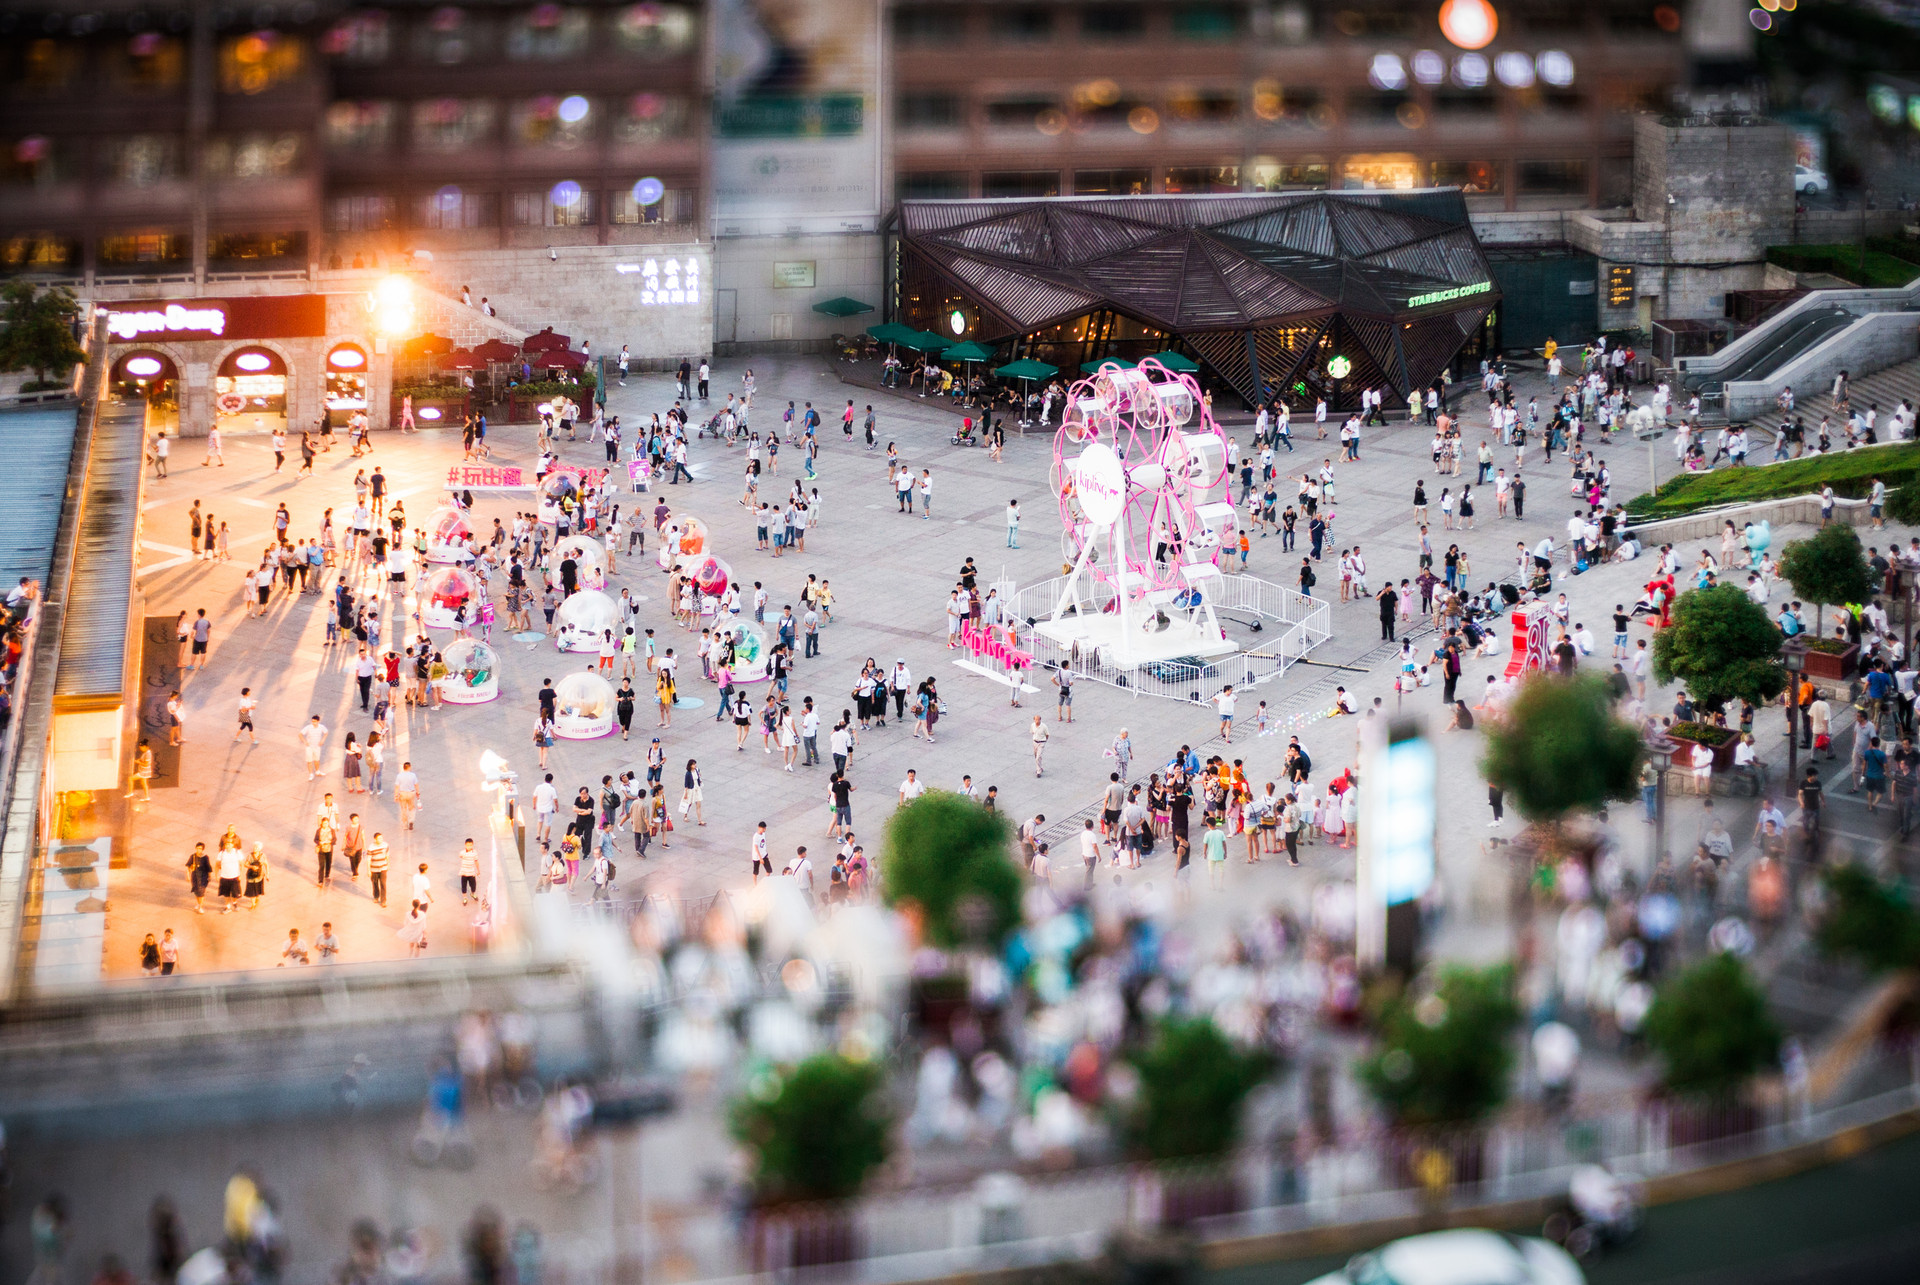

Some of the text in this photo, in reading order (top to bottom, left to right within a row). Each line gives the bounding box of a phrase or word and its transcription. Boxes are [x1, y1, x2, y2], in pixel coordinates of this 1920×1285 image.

[1408, 281, 1491, 308] STARBUCKS COFFEE
[1080, 470, 1108, 501] kipling
[961, 618, 1012, 670] kipling
